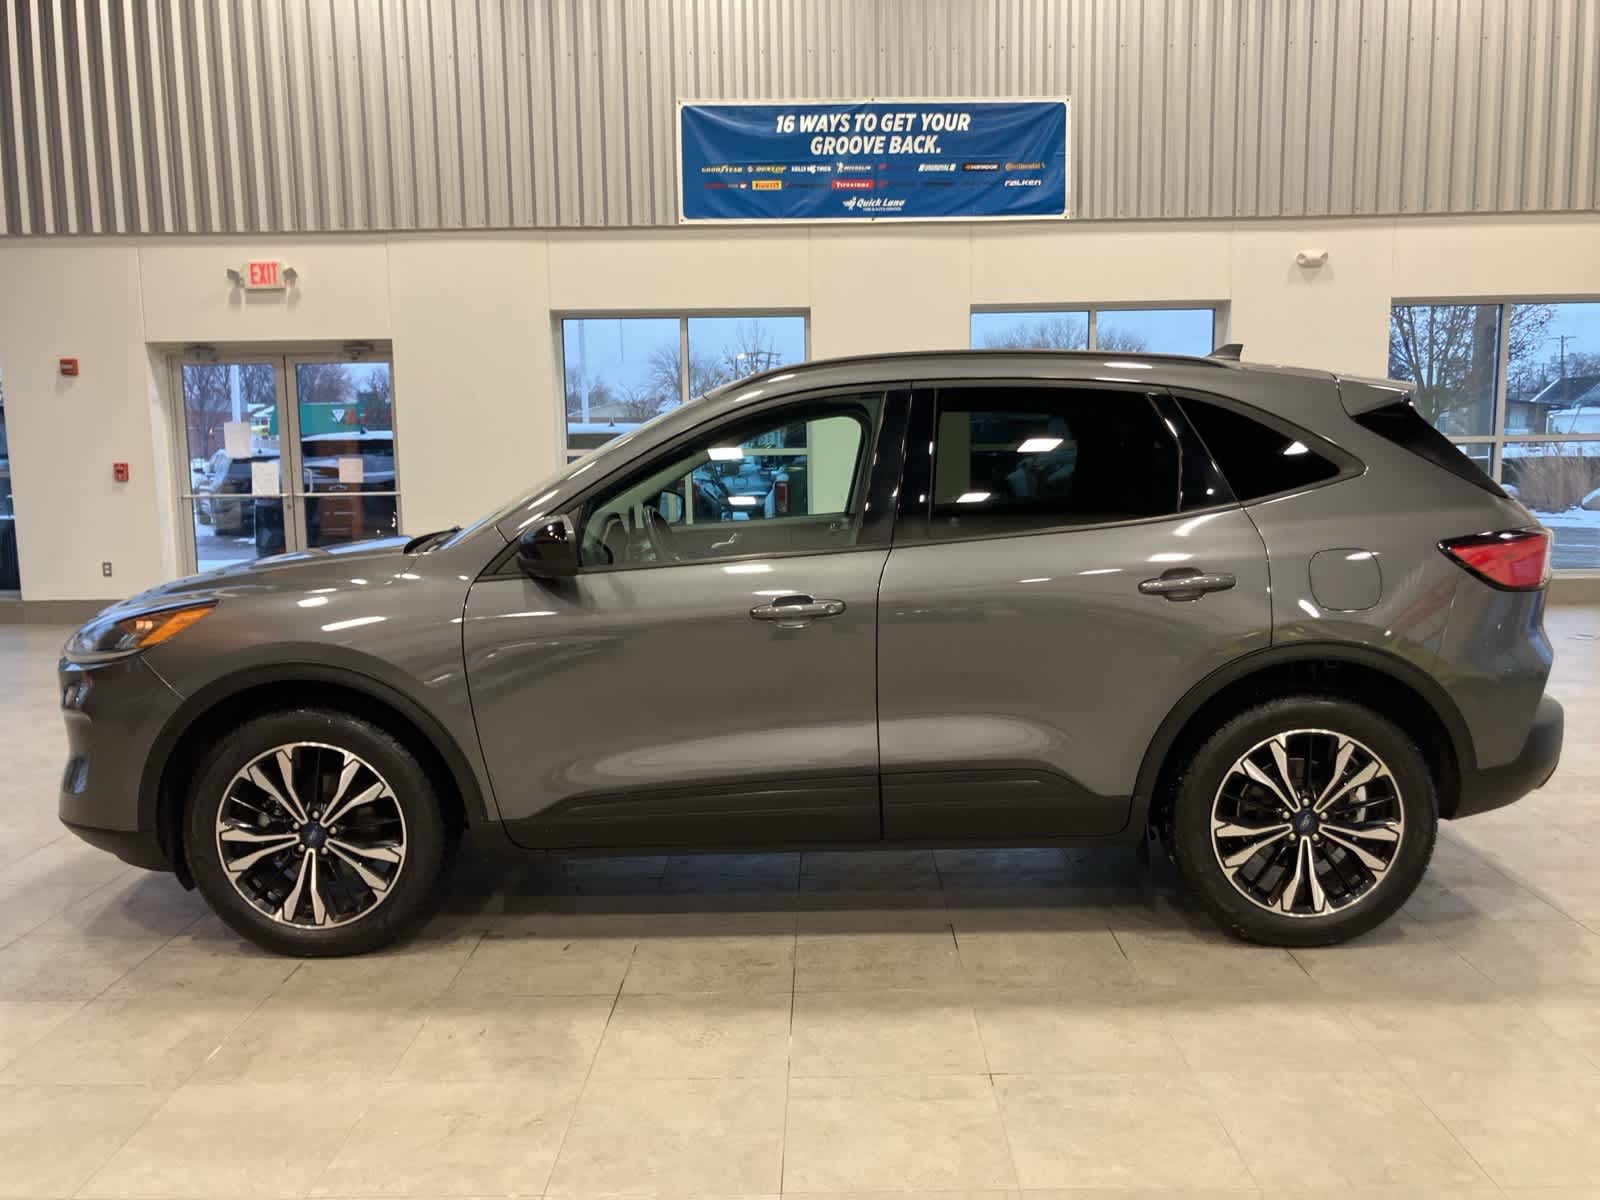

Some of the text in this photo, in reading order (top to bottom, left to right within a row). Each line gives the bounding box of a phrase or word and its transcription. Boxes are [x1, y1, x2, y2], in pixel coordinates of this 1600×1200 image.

[775, 113, 971, 134] 16 WAYS TO GET YOUR
[810, 135, 942, 155] GROOVE BACK.
[856, 197, 905, 208] Quick Lane
[249, 262, 279, 286] EXIT
